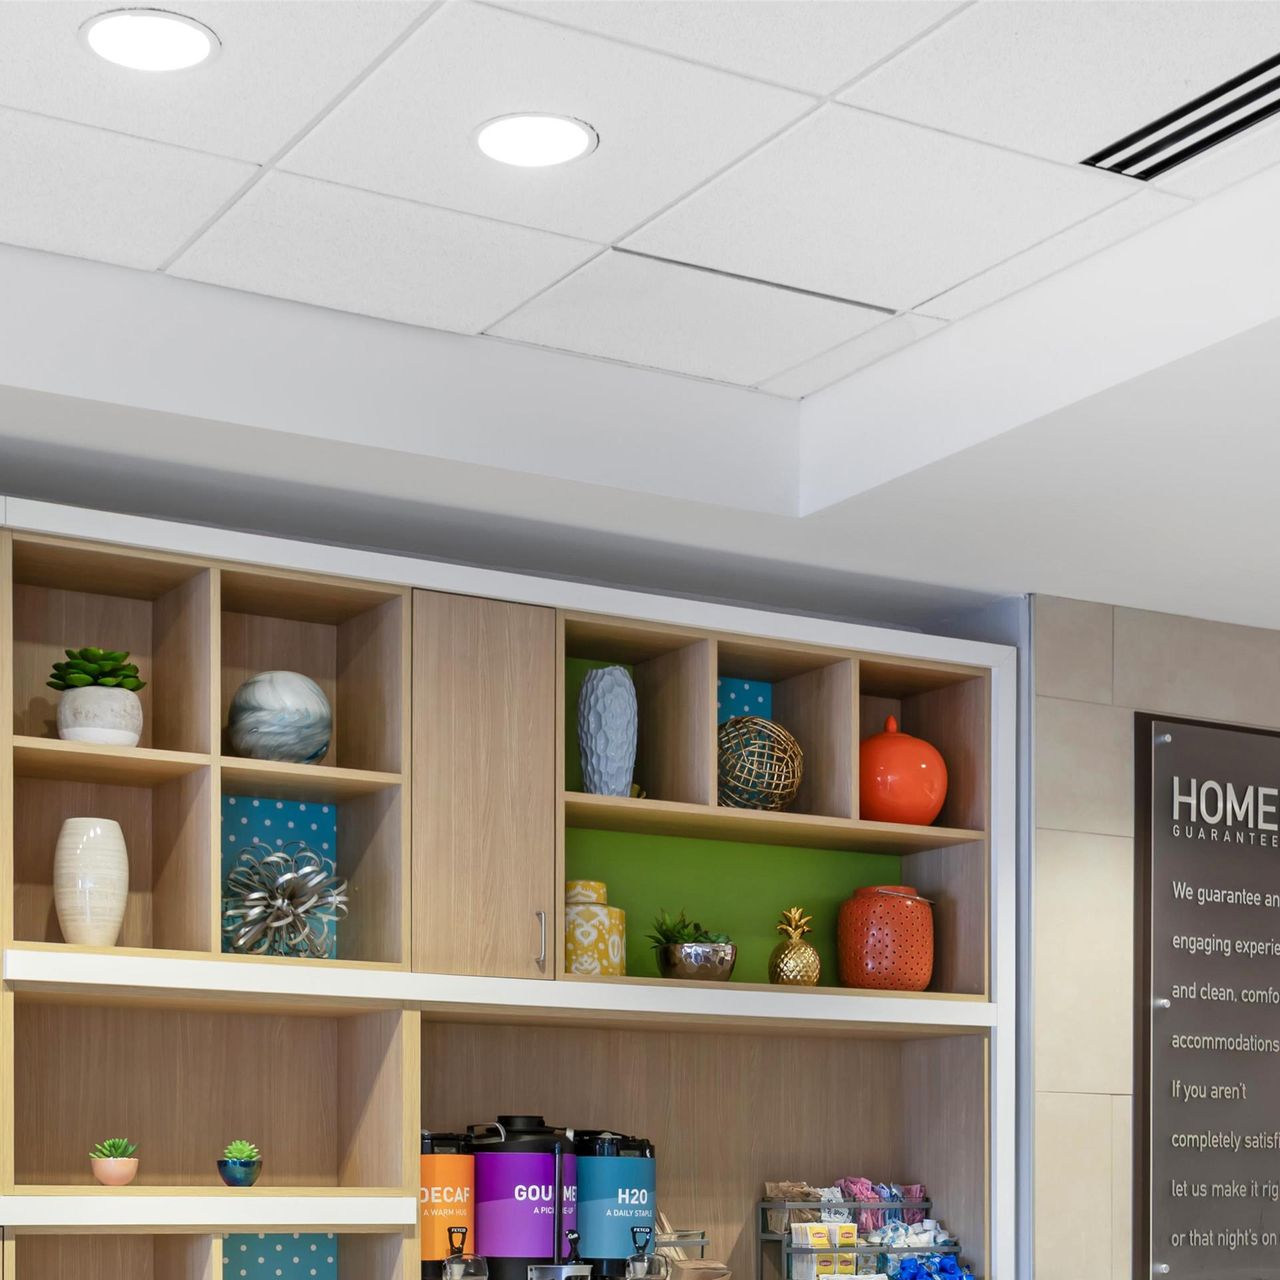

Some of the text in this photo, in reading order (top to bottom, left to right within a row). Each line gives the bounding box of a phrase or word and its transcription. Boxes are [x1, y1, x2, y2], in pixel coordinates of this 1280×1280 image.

[1172, 824, 1279, 848] GUARANTEE
[1172, 881, 1280, 908] We guarantee an
[1172, 934, 1232, 957] engaging
[1172, 982, 1196, 999] and
[1172, 1080, 1247, 1102] If you aren't
[1172, 1130, 1241, 1152] completely
[420, 1186, 470, 1203] DECAF
[1172, 1179, 1187, 1197] let
[1191, 1183, 1207, 1197] us
[1211, 1180, 1247, 1197] make
[1251, 1180, 1258, 1197] it
[423, 1208, 467, 1217] A WARM HUG
[533, 1206, 540, 1215] A
[606, 1209, 612, 1217] A
[613, 1209, 633, 1217] DAILY
[1171, 1233, 1186, 1247] or
[1189, 1229, 1214, 1247] that
[1217, 1228, 1258, 1250] night's
[1262, 1232, 1277, 1246] on
